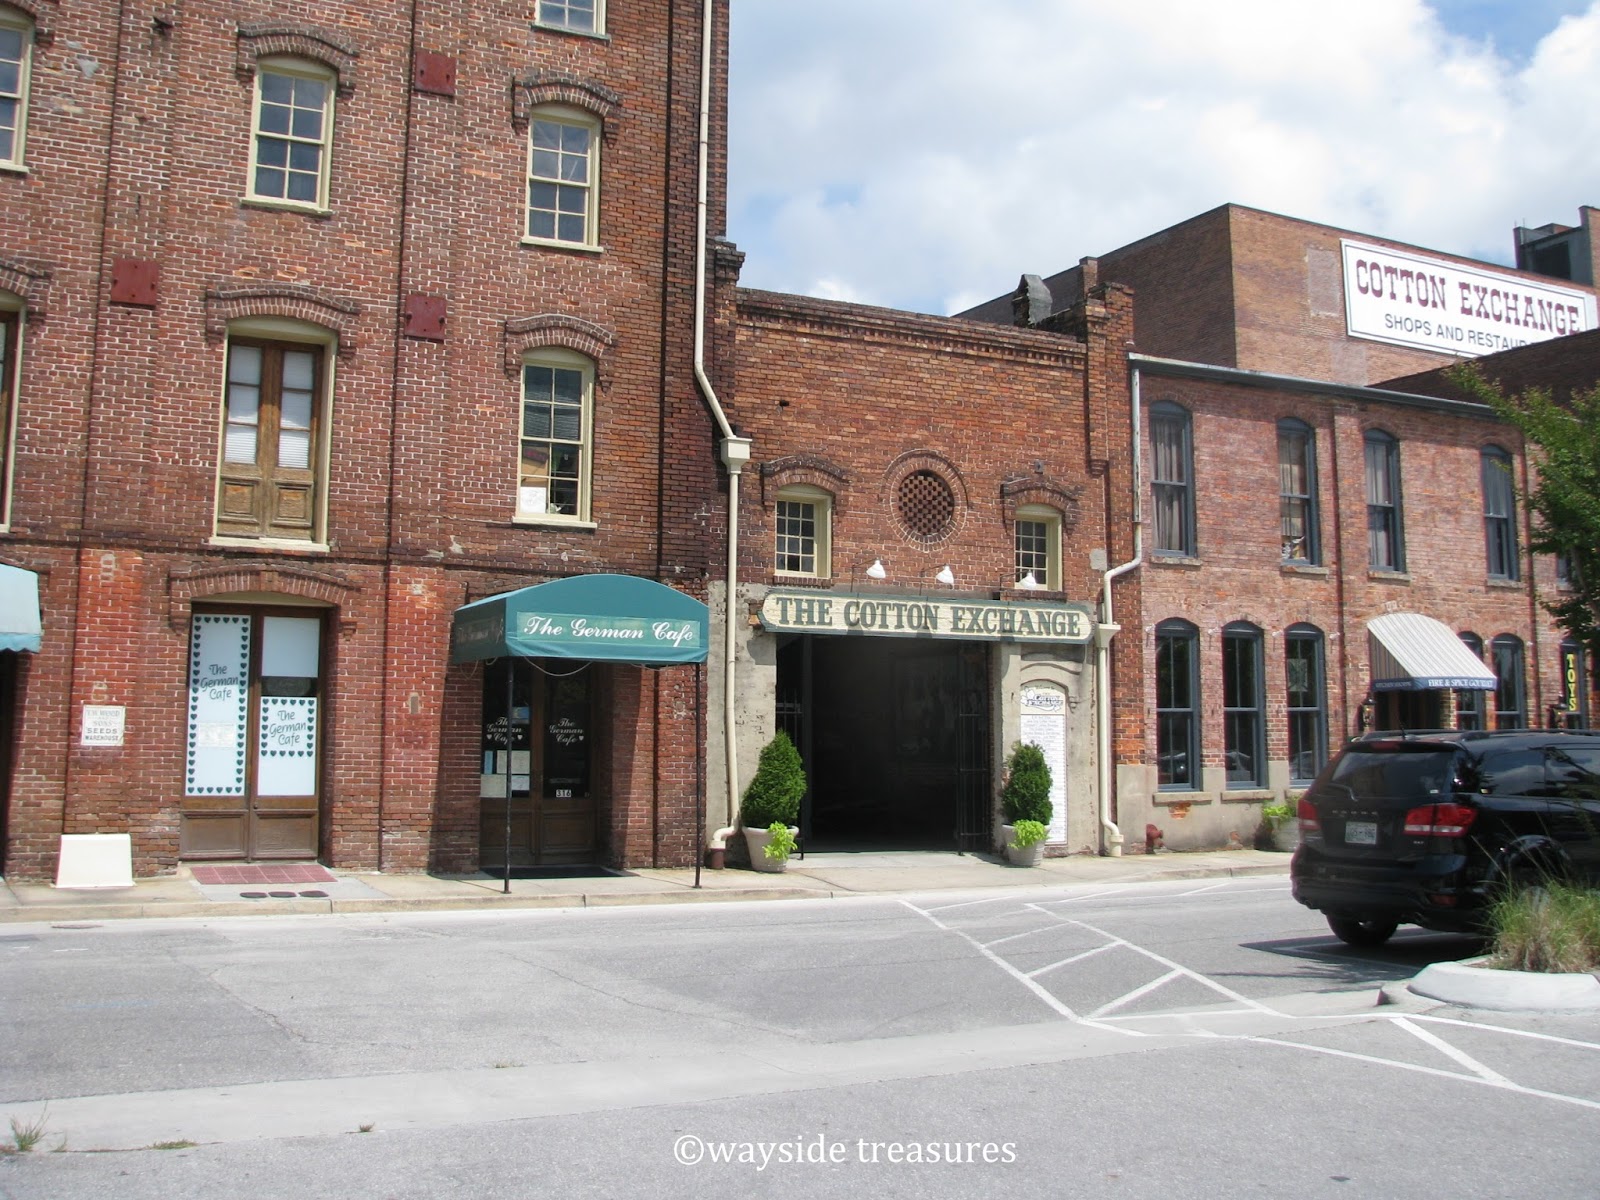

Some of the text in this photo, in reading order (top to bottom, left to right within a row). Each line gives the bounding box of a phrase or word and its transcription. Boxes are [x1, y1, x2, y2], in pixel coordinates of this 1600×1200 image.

[1356, 259, 1580, 336] COTTON EXCHANGE
[1384, 313, 1432, 336] SHOPS
[1436, 324, 1464, 342] AND
[776, 597, 1080, 637] THE COTTON EXCHANGE
[524, 616, 563, 635] The
[571, 618, 643, 639] German
[652, 621, 693, 648] Cafe
[209, 664, 228, 675] The
[200, 677, 239, 692] German
[1566, 653, 1577, 712] TOYS
[209, 688, 232, 701] Cafe
[277, 710, 296, 720] The
[495, 716, 508, 726] Th
[557, 717, 575, 727] The
[269, 722, 307, 737] German
[549, 724, 584, 734] German
[278, 733, 301, 746] Cafe
[556, 733, 577, 746] Cafe
[556, 789, 571, 798] 316
